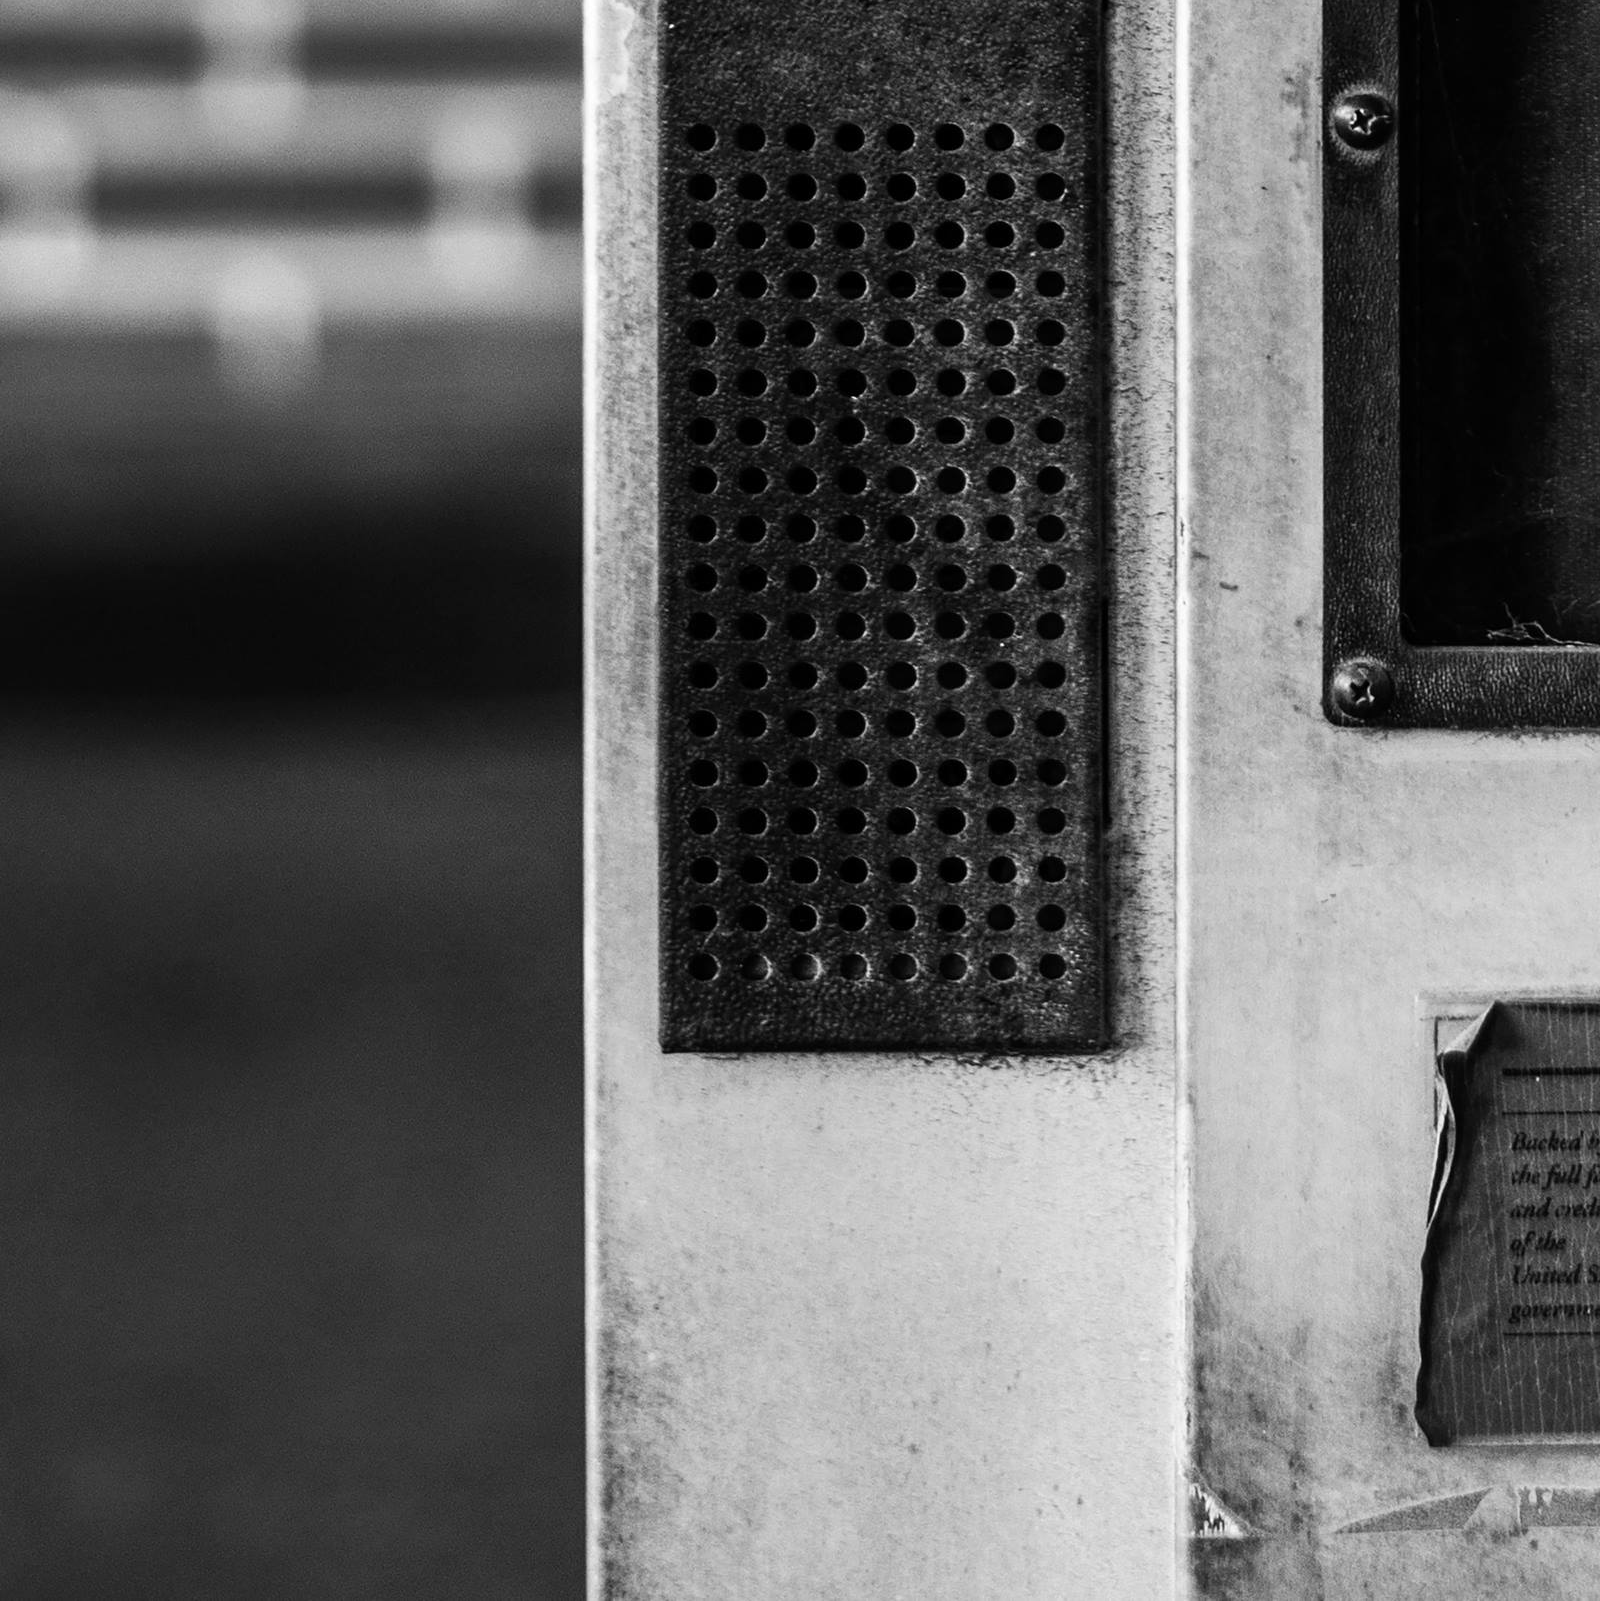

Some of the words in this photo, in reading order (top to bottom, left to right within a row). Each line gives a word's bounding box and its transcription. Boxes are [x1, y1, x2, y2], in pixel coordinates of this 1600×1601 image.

[1511, 1130, 1584, 1151] Backed
[1541, 1164, 1583, 1190] full
[1510, 1197, 1551, 1219] and
[1510, 1231, 1535, 1258] of
[1535, 1231, 1567, 1251] the
[1513, 1262, 1582, 1285] United
